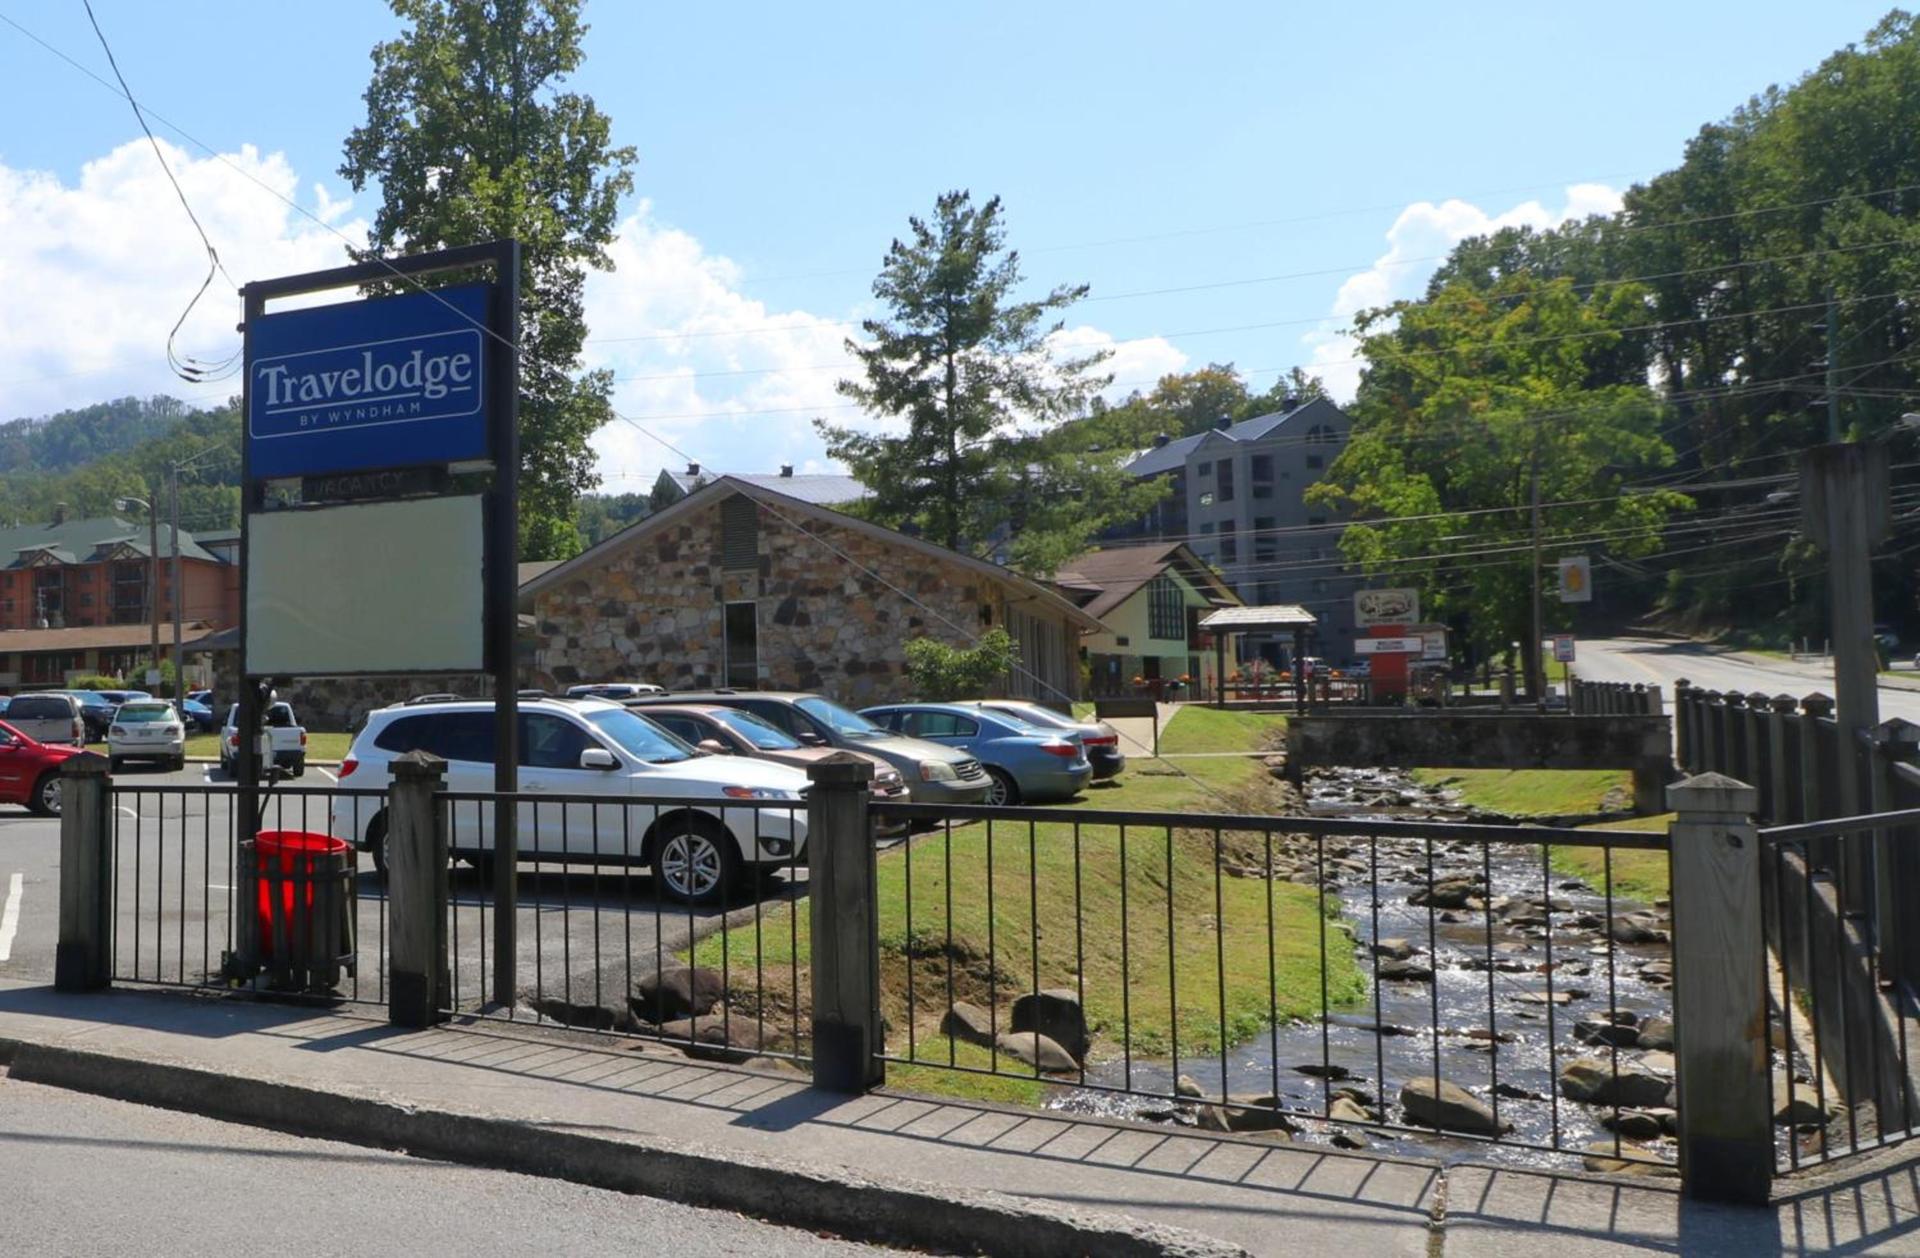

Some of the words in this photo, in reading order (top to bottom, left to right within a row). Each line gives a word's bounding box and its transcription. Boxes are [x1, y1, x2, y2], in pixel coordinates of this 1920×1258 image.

[258, 350, 472, 406] Travelodge
[300, 414, 319, 427] BY
[328, 402, 421, 424] WYNDHAM
